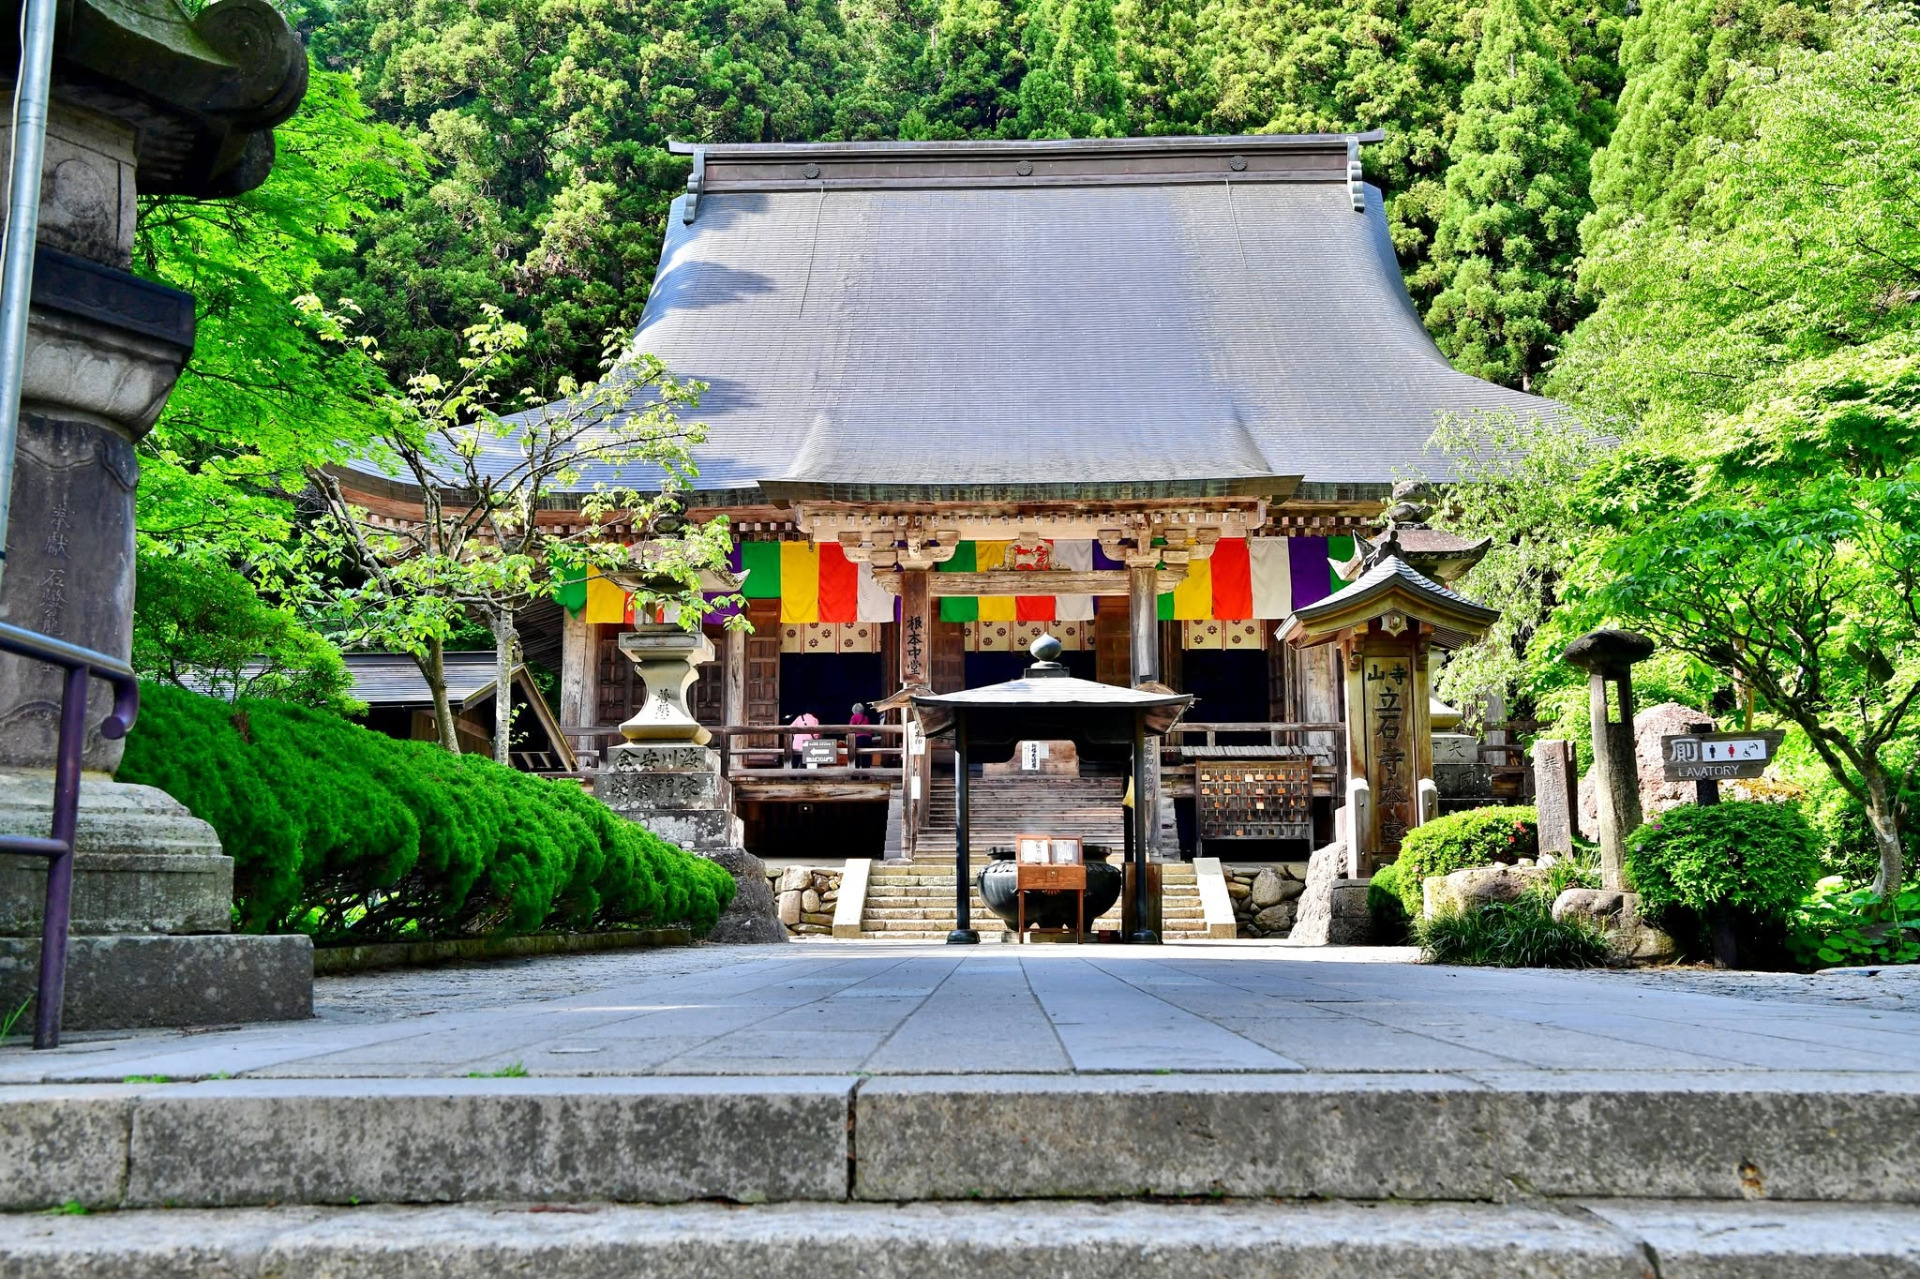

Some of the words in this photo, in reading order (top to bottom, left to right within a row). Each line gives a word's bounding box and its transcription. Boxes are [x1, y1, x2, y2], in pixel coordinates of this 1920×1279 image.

[906, 615, 923, 676] 根本中堂
[1367, 664, 1409, 686] 山寺
[1669, 739, 1699, 762] 厠
[1375, 686, 1409, 845] 立石寺本堂
[1678, 764, 1740, 777] LAVATORY
